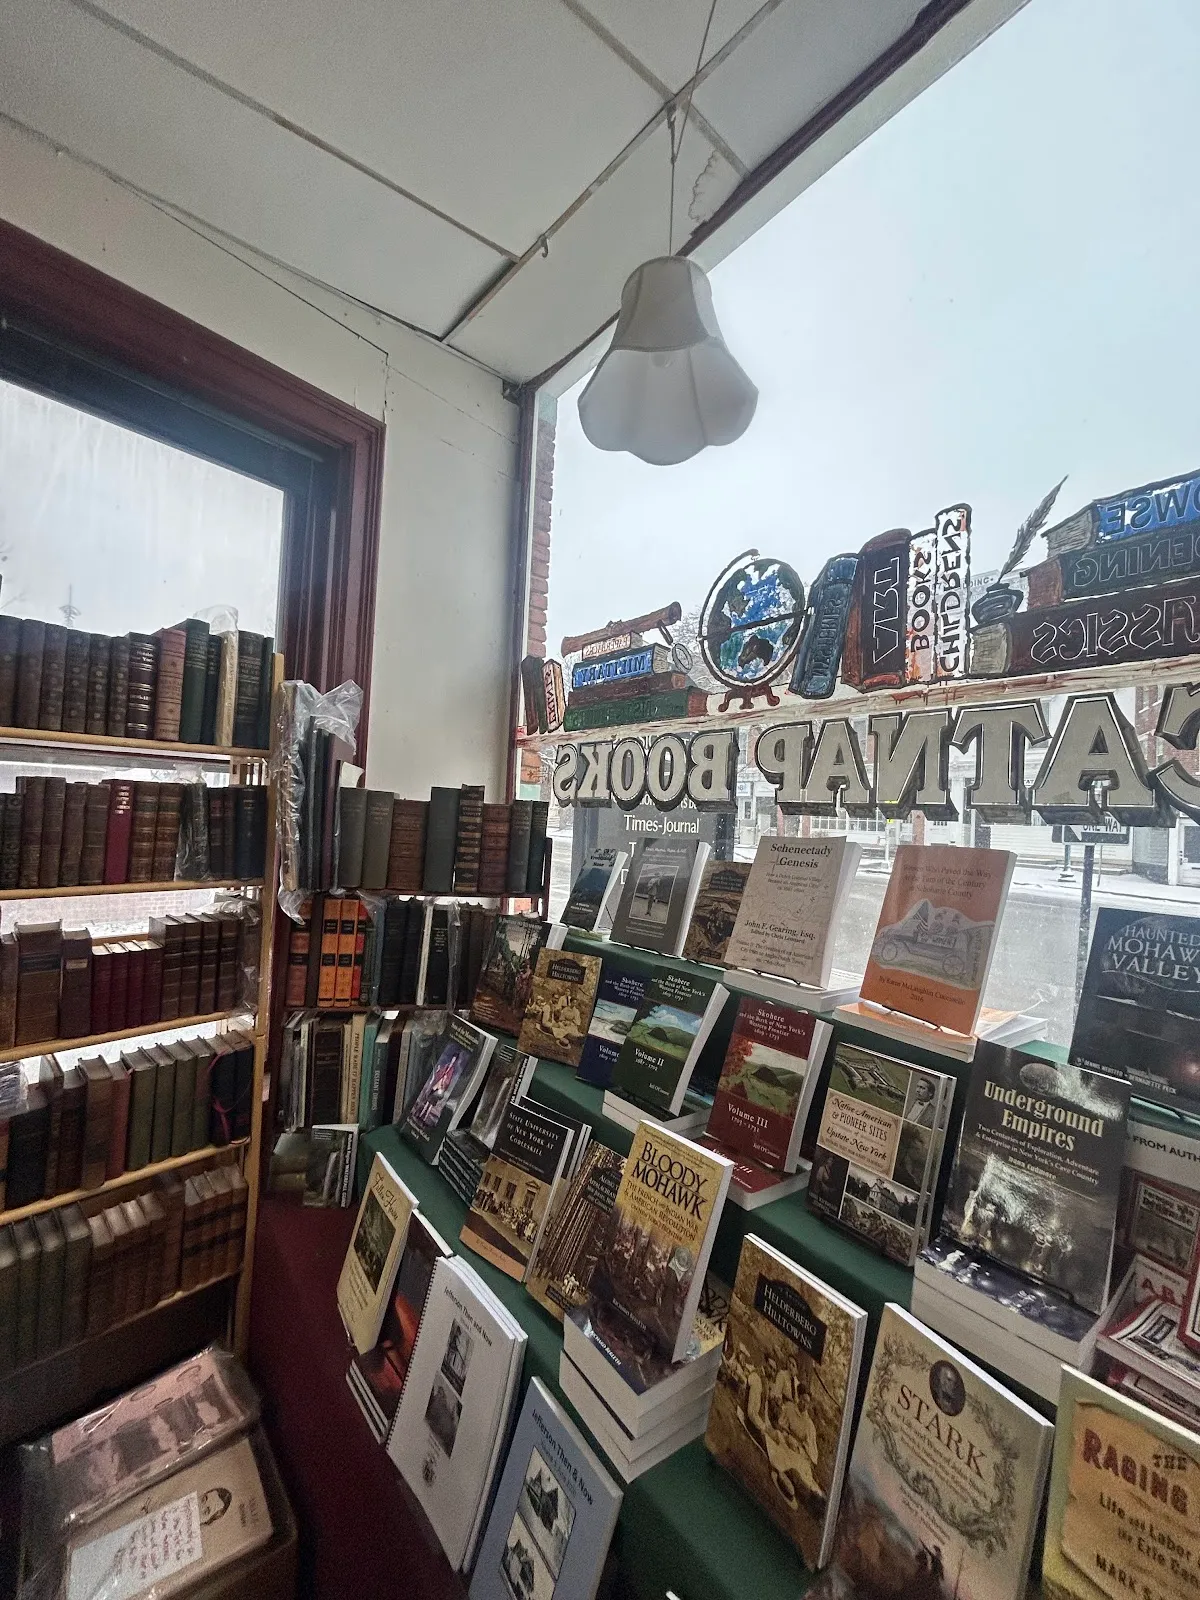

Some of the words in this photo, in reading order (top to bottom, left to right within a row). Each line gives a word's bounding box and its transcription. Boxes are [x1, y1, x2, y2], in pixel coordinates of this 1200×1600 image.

[624, 814, 699, 835] Times-Journal
[770, 843, 833, 857] Schenectady
[778, 857, 819, 869] Genesis
[957, 879, 986, 889] Century
[976, 869, 992, 878] Way
[744, 920, 761, 929] John
[800, 930, 816, 940] Esq.
[1124, 925, 1200, 947] HAUNTED
[552, 963, 582, 976] HELDERBERG
[552, 971, 579, 982] HILLTOWNS
[622, 977, 644, 988] Skohere
[667, 975, 691, 987] Skohere
[902, 980, 934, 997] McLaughlin
[748, 1020, 768, 1032] Western
[768, 1025, 790, 1037] Frontier
[755, 1015, 768, 1026] Birth
[776, 1021, 787, 1030] New
[788, 1025, 806, 1036] York's
[758, 1009, 785, 1023] Skohere
[635, 1048, 657, 1063] Volume
[657, 1058, 665, 1067] II
[373, 1069, 381, 1092] DISTANT
[1084, 1060, 1101, 1071] DENNIS
[1162, 1083, 1178, 1095] PECK
[728, 1103, 756, 1123] Volume
[756, 1116, 769, 1129] III
[832, 1098, 856, 1113] Native
[856, 1109, 892, 1129] American
[983, 1080, 1105, 1138] Underground
[510, 1112, 523, 1124] STATE
[525, 1119, 559, 1141] UNIVERSITY
[515, 1125, 527, 1137] NEW
[529, 1132, 545, 1146] YORK
[839, 1111, 868, 1133] PIONEER
[869, 1125, 889, 1142] SITES
[1001, 1108, 1076, 1152] Empires
[510, 1134, 543, 1157] COBLESKILL
[826, 1126, 850, 1143] Upstate
[850, 1138, 869, 1152] New
[870, 1146, 888, 1161] York
[978, 1123, 991, 1134] Two
[991, 1127, 1020, 1145] Centuries
[1027, 1142, 1064, 1162] Exploration,
[1065, 1157, 1100, 1176] Adventure
[1133, 1136, 1167, 1152] FROM
[641, 1141, 708, 1193] BLOODY
[982, 1133, 1011, 1150] Enterprise
[1019, 1147, 1033, 1160] New
[1034, 1152, 1054, 1167] York's
[1055, 1161, 1072, 1175] Cave
[1071, 1168, 1100, 1187] Country
[1026, 1160, 1057, 1180] Cudmore
[631, 1160, 706, 1220] MOHAWK
[629, 1191, 658, 1216] AMERICAN
[658, 1210, 696, 1241] REVOLUTION
[637, 1186, 659, 1206] FRENCH
[665, 1205, 687, 1223] INDIAN
[686, 1218, 700, 1234] WAR
[444, 1286, 463, 1312] Jefferson
[462, 1305, 474, 1324] Then
[482, 1329, 493, 1347] Now
[764, 1284, 817, 1336] HELDERBERG
[763, 1300, 812, 1349] HILLTOWNS
[898, 1384, 988, 1482] STARK
[531, 1408, 558, 1451] Jefferson
[557, 1443, 573, 1474] Then
[578, 1476, 594, 1506] Now
[1099, 1491, 1126, 1520] Life
[1149, 1523, 1192, 1561] Labor
[1137, 1536, 1166, 1567] Erie
[1096, 1552, 1137, 1595] MARK
